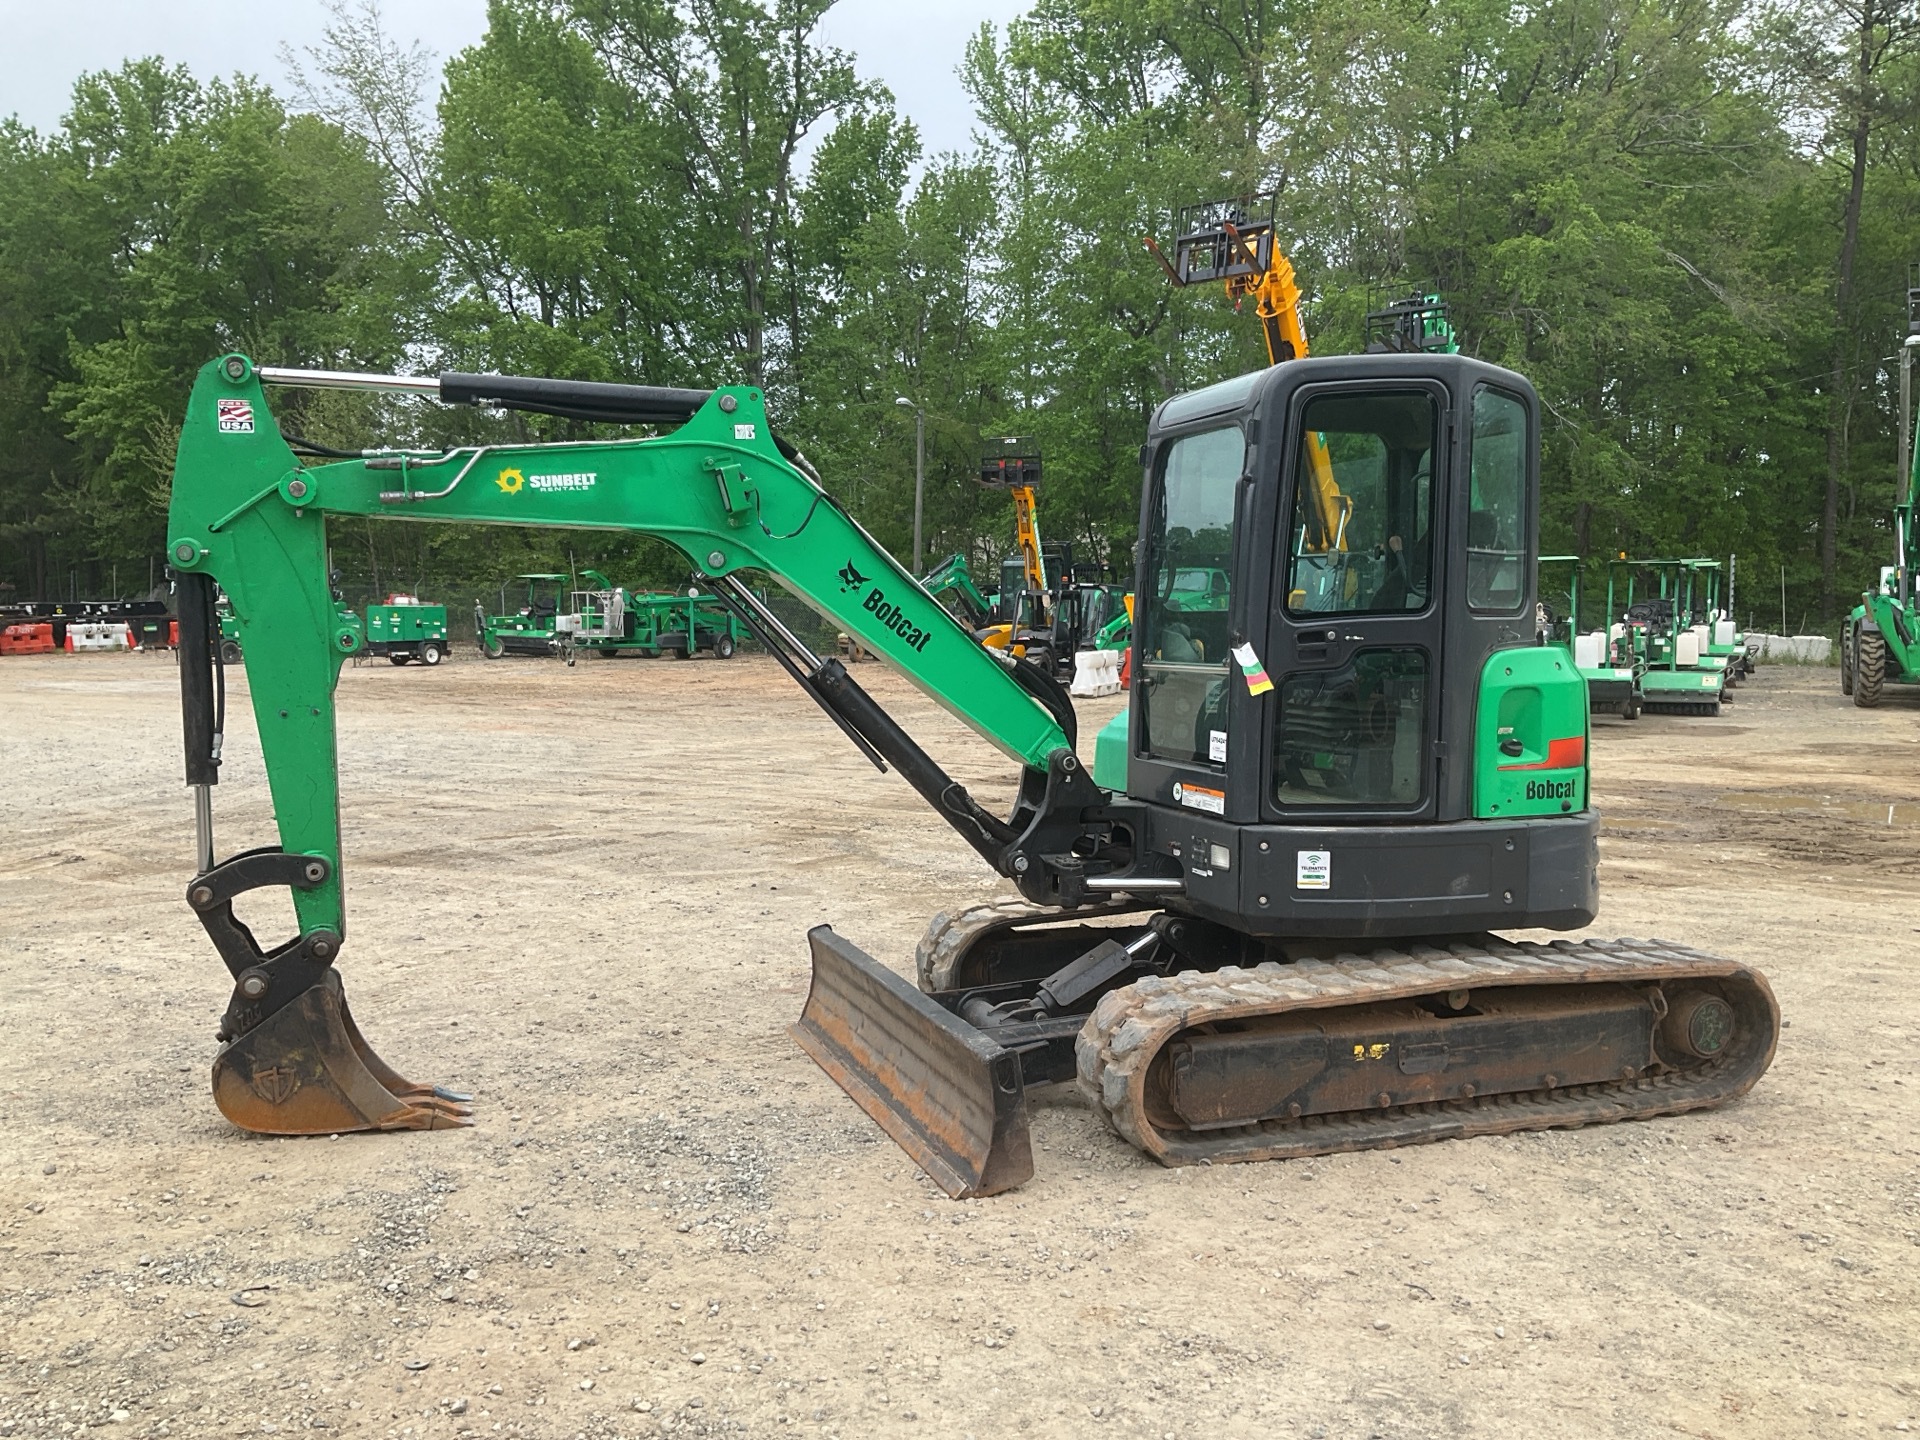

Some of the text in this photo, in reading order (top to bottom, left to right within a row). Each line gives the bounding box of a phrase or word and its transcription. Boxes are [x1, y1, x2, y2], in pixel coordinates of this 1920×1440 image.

[221, 421, 252, 431] USA
[529, 472, 597, 488] SUNBELT
[862, 587, 932, 653] Bobcat
[1526, 779, 1576, 800] Bobcat
